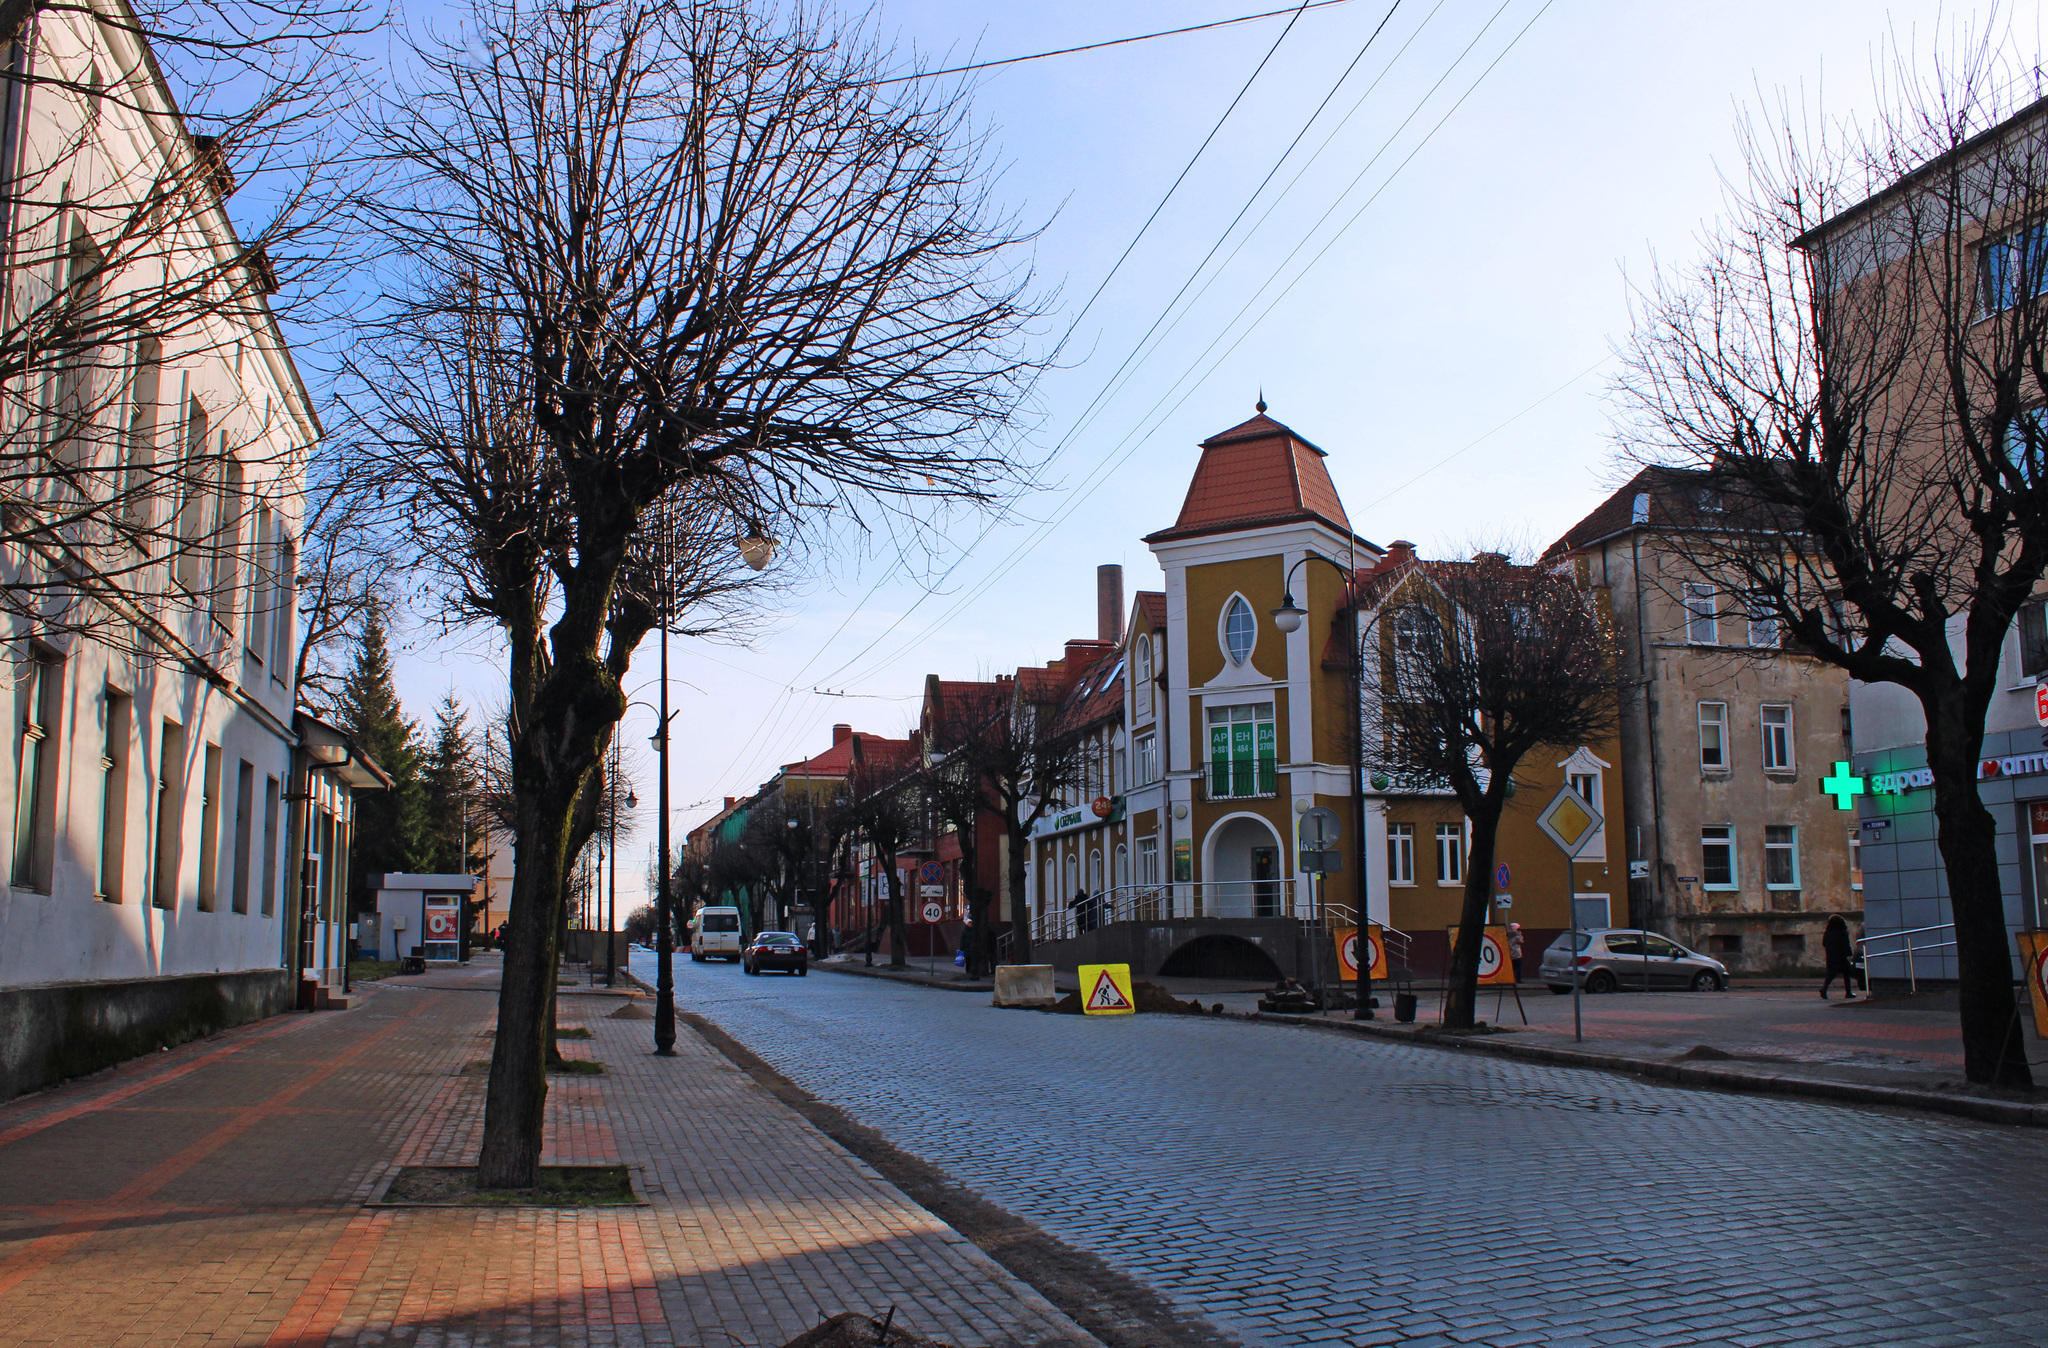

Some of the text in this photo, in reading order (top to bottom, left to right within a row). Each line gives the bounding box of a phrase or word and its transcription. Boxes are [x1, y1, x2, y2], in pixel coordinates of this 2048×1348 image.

[1871, 769, 1935, 796] здрав
[1095, 801, 1107, 810] 24
[925, 908, 939, 917] 40
